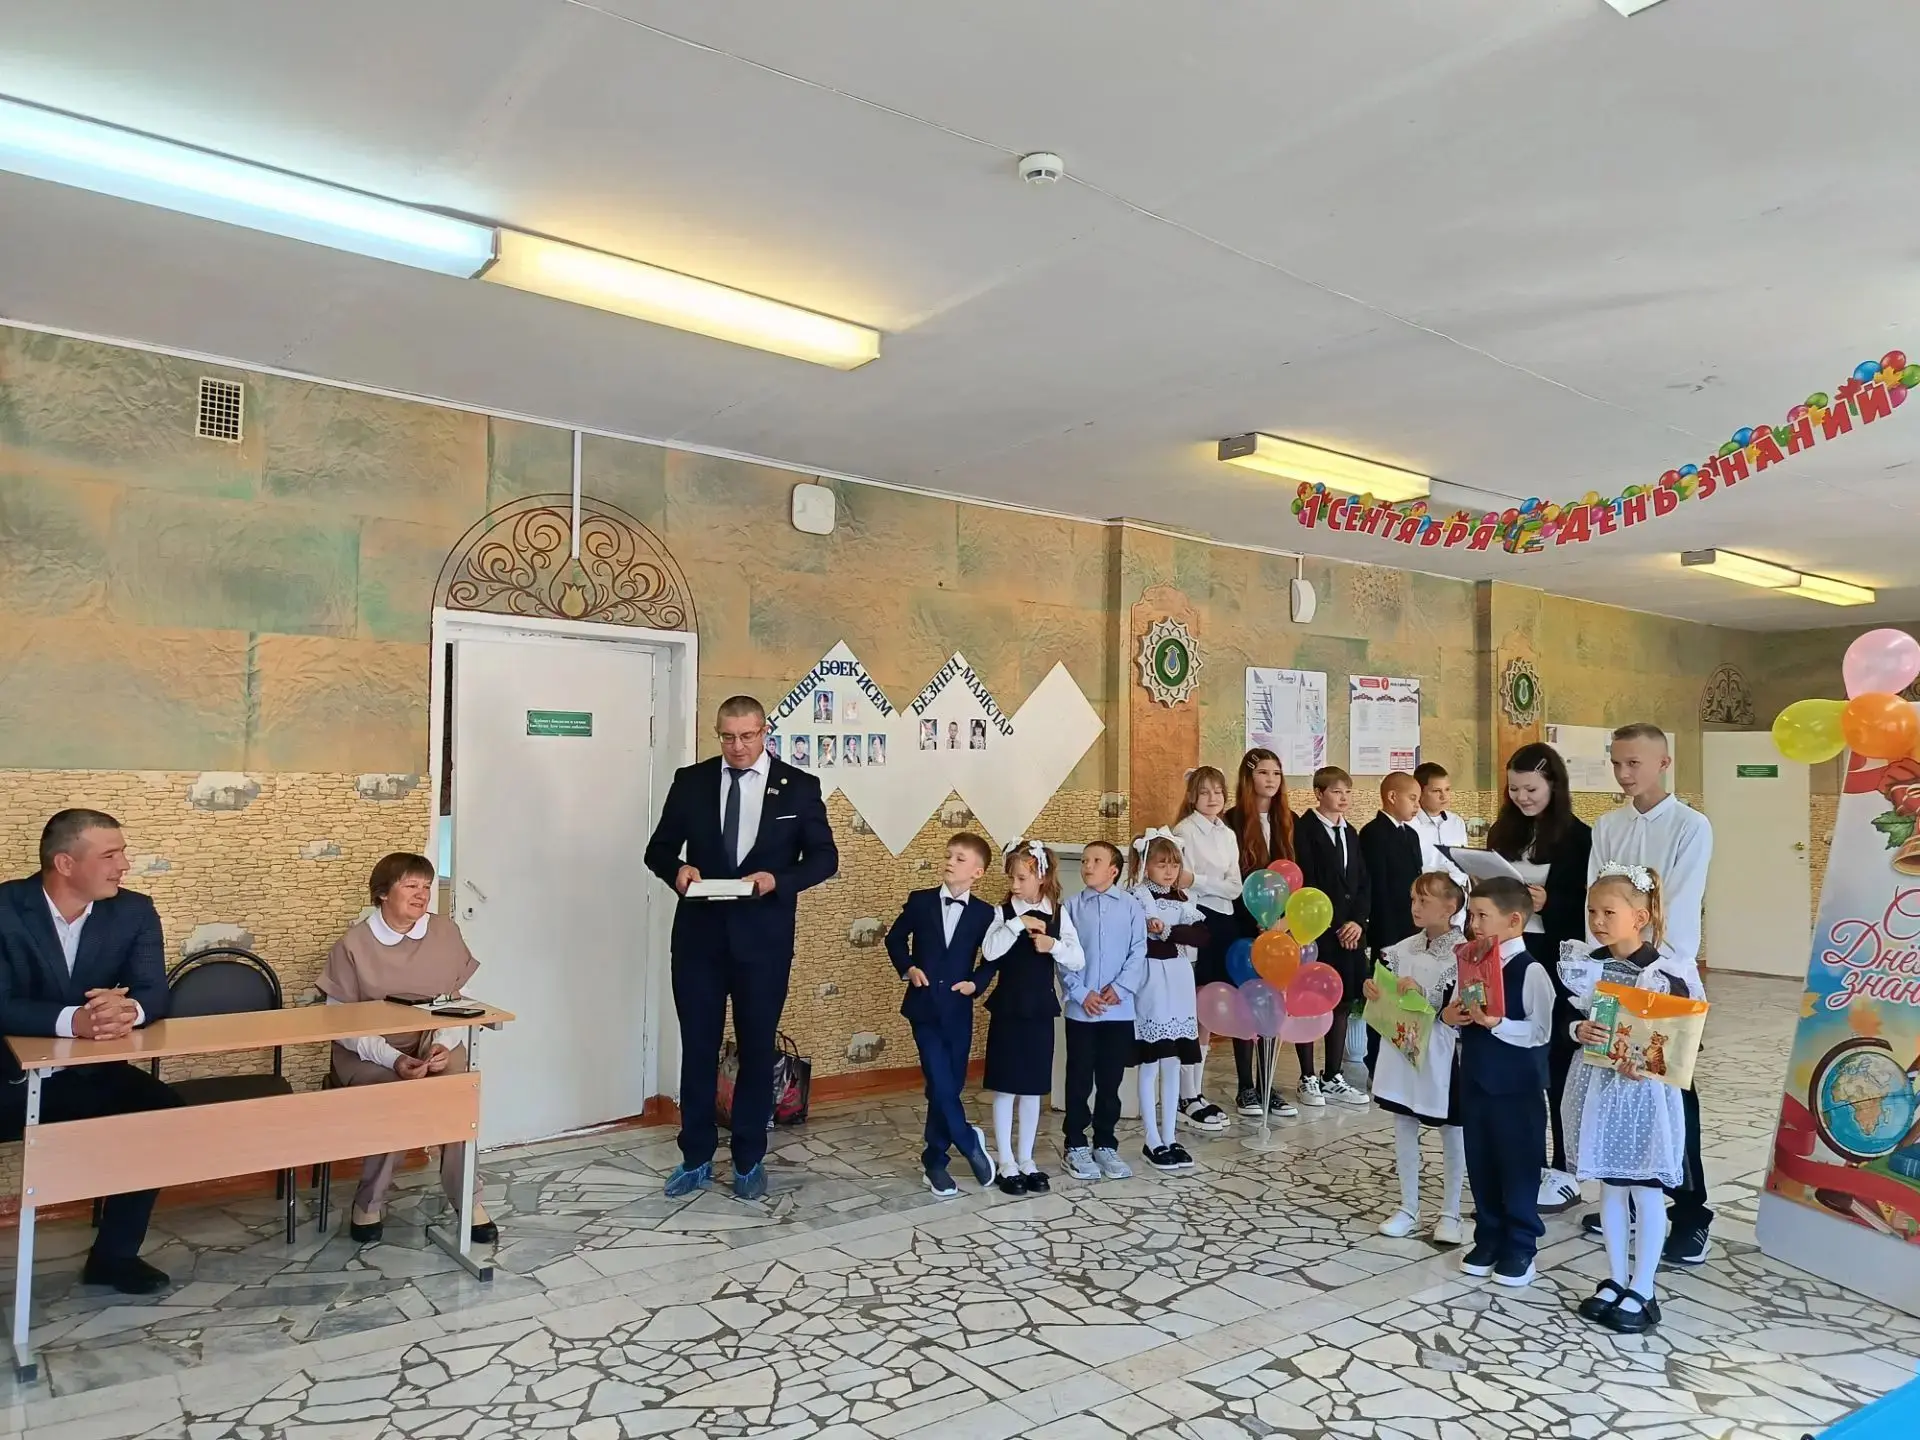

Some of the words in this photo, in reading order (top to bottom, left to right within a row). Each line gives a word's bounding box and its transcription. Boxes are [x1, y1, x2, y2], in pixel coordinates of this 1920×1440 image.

[1304, 494, 1322, 529] 1
[1327, 497, 1498, 553] СЕНТЯБРЯ
[1555, 485, 1679, 546] ДЕНЬ
[1696, 380, 1894, 500] ЗНАНИЙ
[819, 660, 860, 677] БӨЕК
[856, 671, 893, 718] ИСЕМ
[911, 657, 962, 717] БЕЗНЕҢ
[960, 666, 1014, 737] МАЯКЛАР
